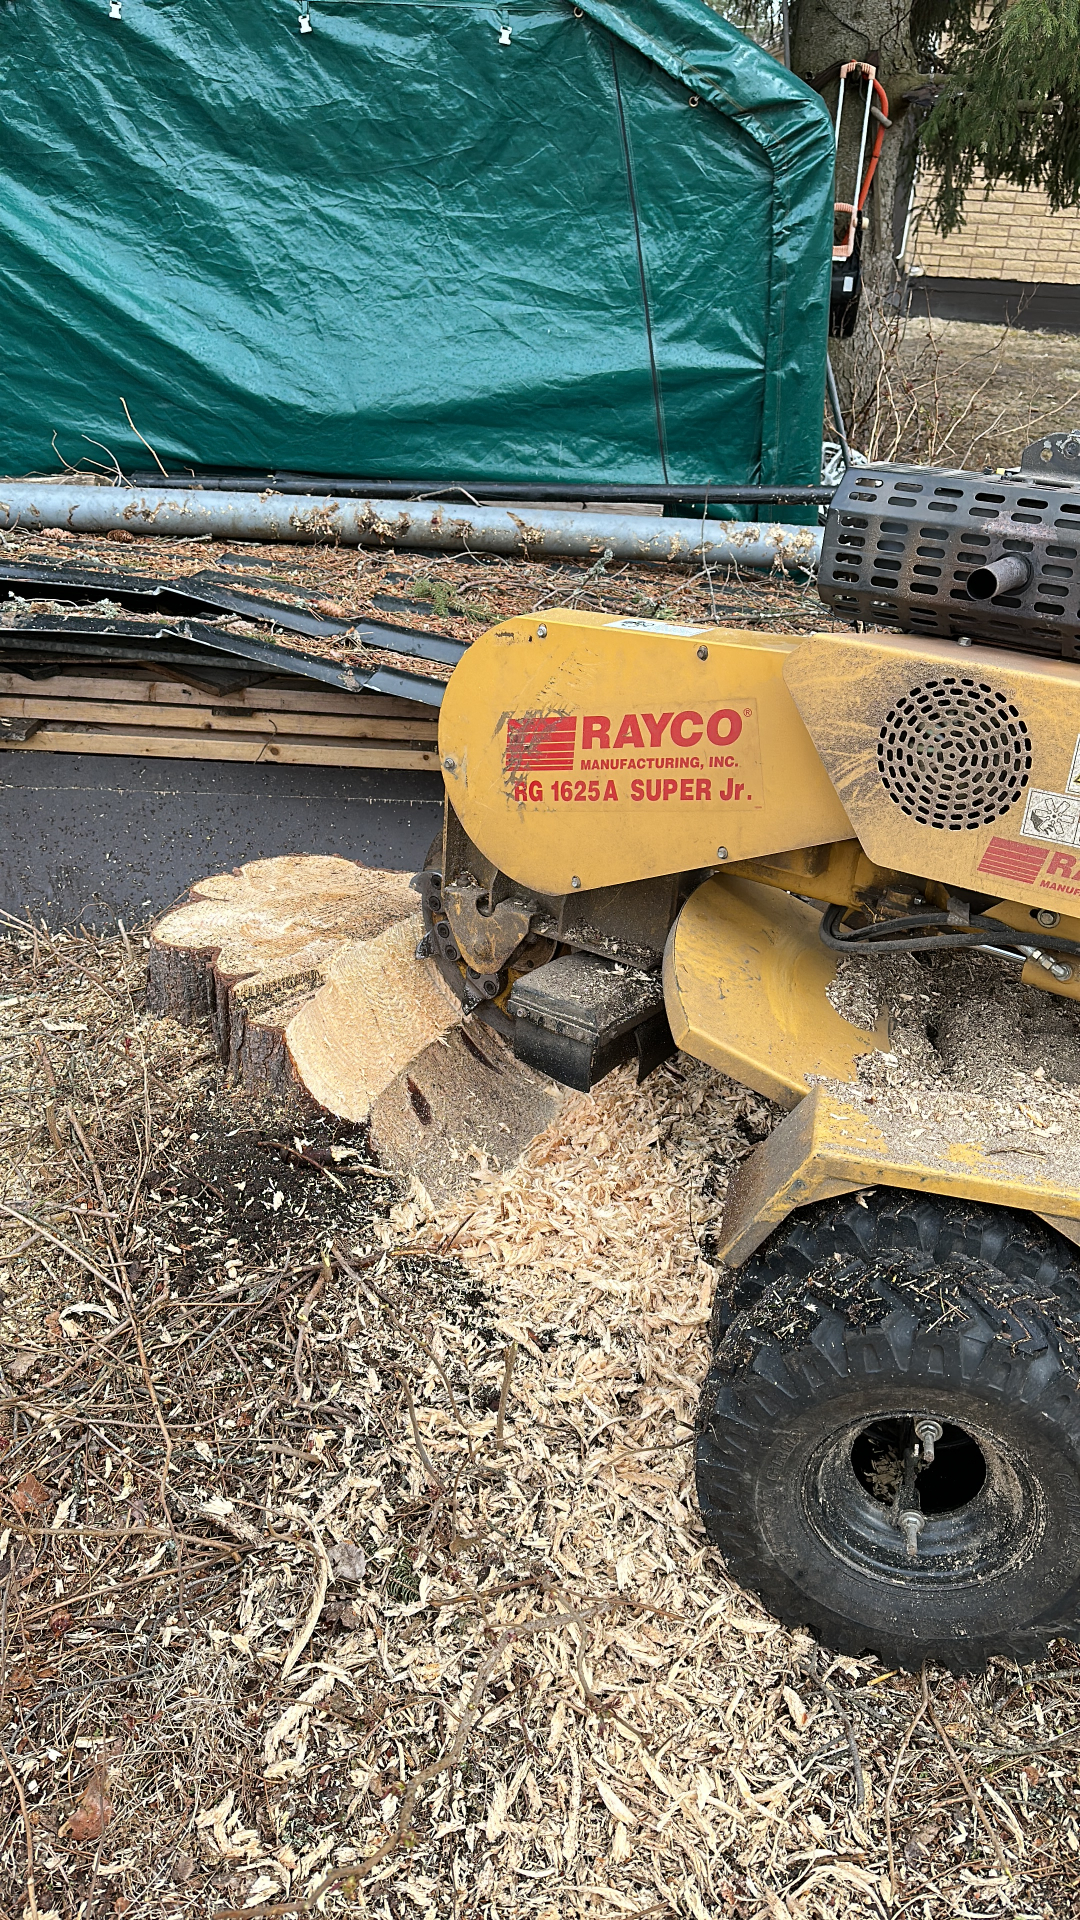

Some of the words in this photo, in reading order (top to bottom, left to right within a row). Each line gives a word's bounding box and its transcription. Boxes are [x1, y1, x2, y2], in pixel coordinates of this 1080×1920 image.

[580, 757, 704, 771] MANUFACTURING,
[708, 756, 739, 768] INC.
[515, 780, 544, 802] RG
[551, 779, 619, 802] 1625A
[630, 778, 712, 802] SUPER
[719, 777, 752, 802] Jr.
